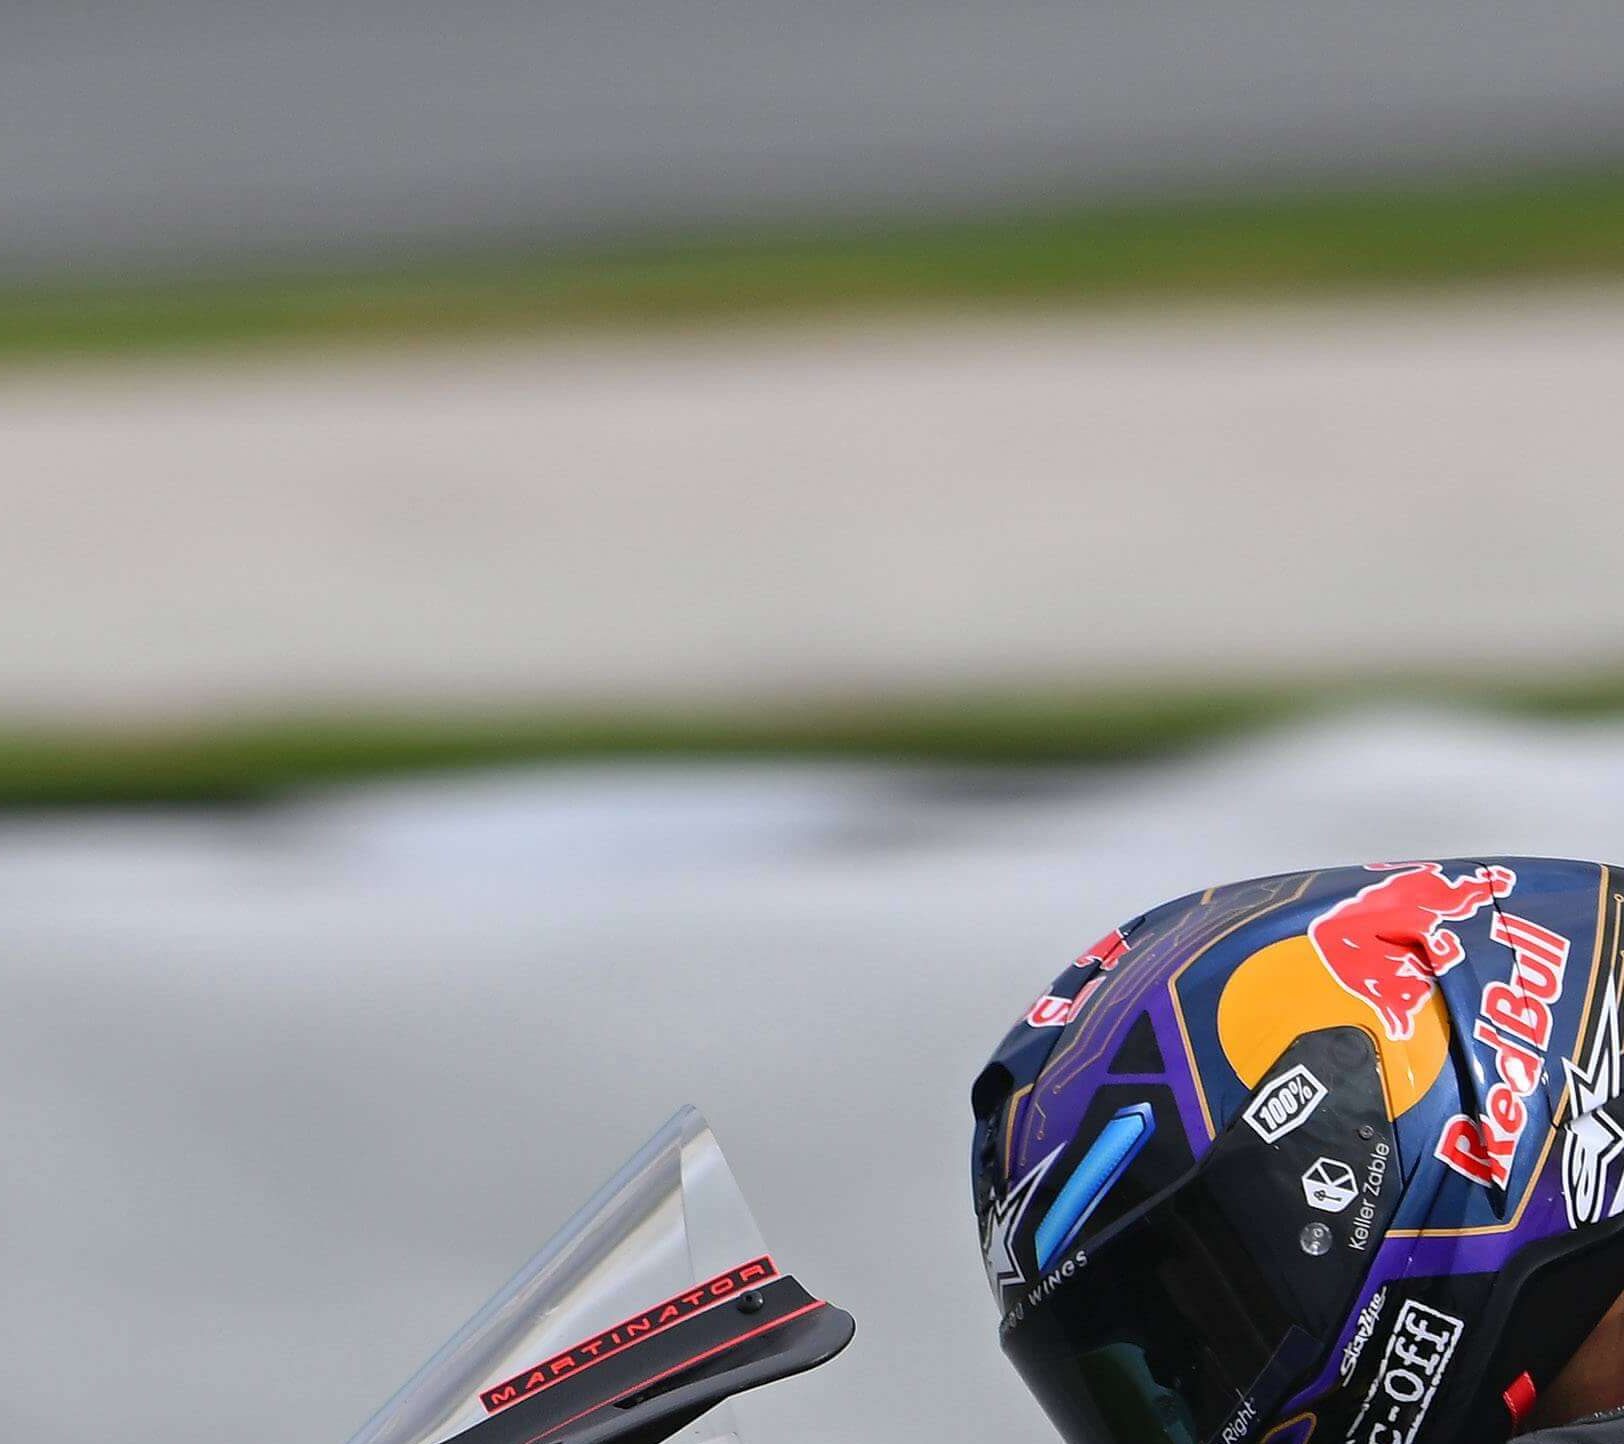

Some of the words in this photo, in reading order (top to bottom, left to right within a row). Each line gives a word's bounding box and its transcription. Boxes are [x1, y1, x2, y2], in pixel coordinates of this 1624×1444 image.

[1259, 1076, 1313, 1130] 100%
[1362, 1142, 1390, 1197] Zable
[1348, 1199, 1377, 1251] Keller
[1028, 1250, 1089, 1306] WINGS
[491, 1264, 765, 1405] MARTINATOR
